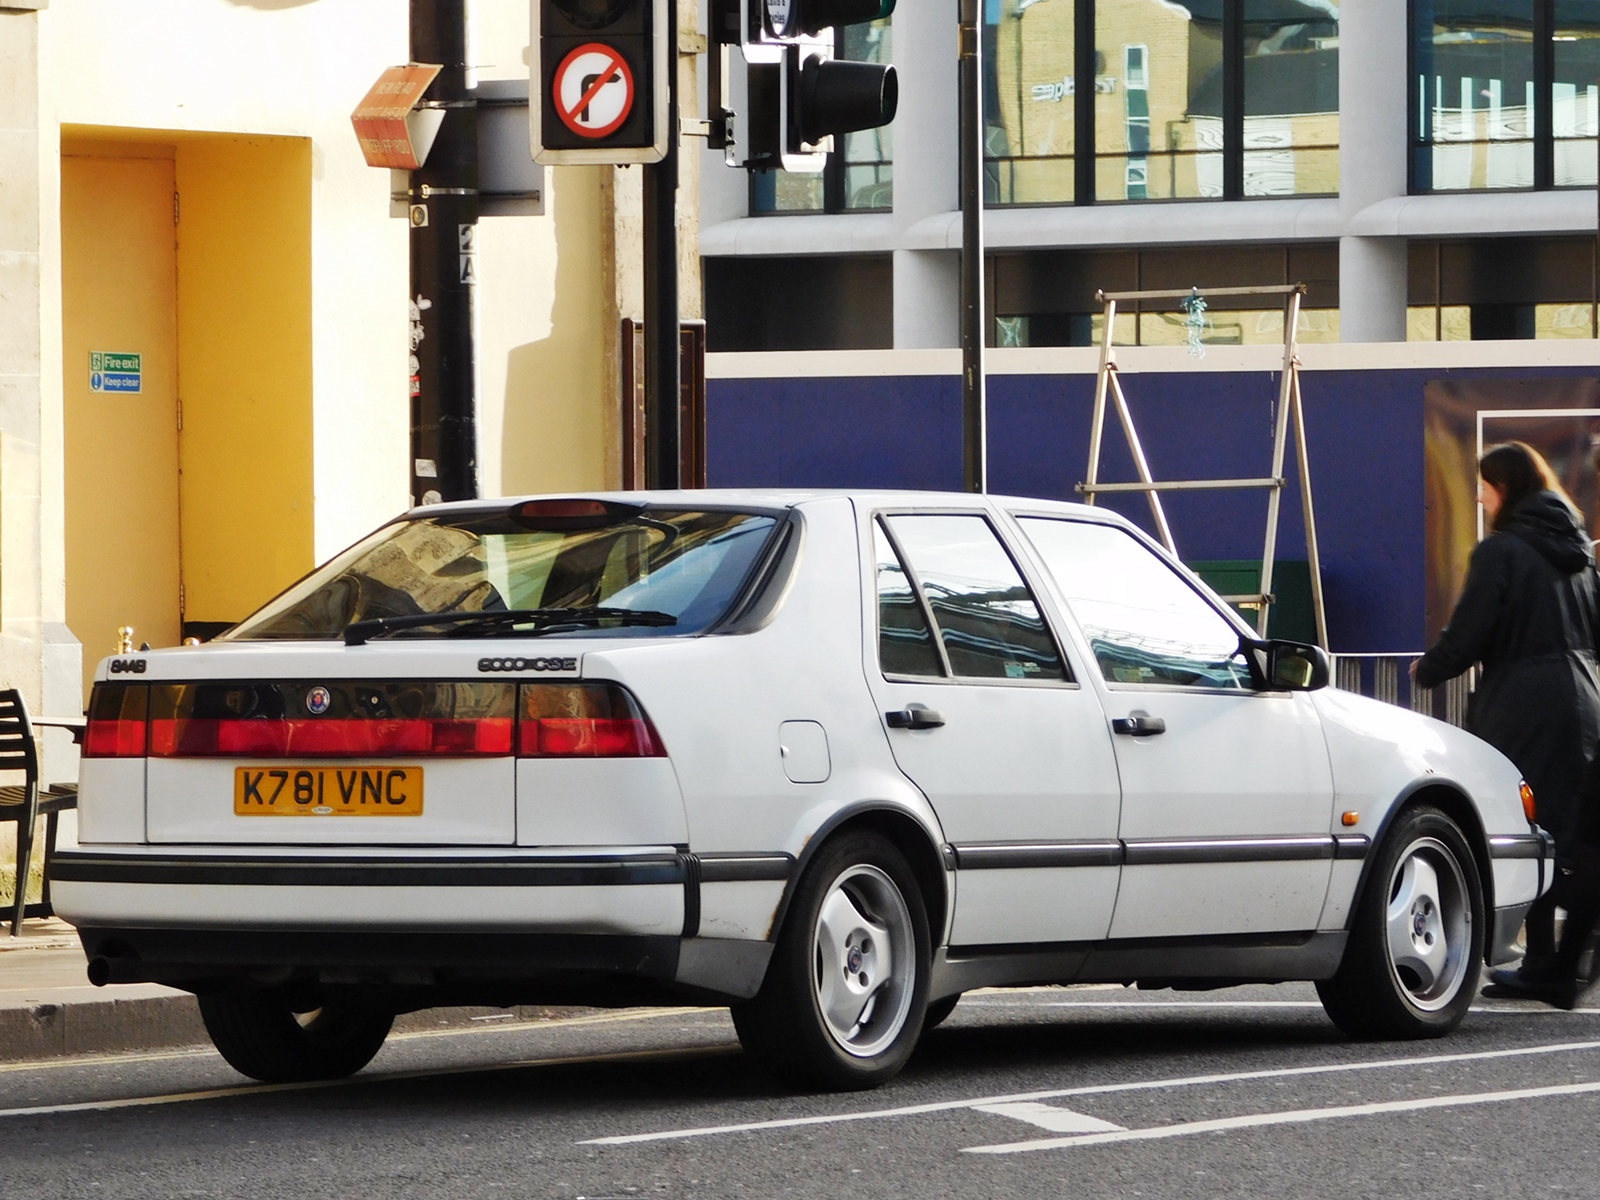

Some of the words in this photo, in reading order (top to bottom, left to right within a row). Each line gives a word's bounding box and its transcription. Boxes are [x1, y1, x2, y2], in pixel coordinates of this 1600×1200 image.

[461, 225, 473, 251] 2
[461, 256, 475, 281] A
[104, 356, 121, 369] Fire
[122, 356, 139, 369] exit
[104, 376, 121, 389] Keep
[122, 377, 139, 387] clear
[243, 770, 324, 805] K781
[336, 770, 407, 805] VNC
